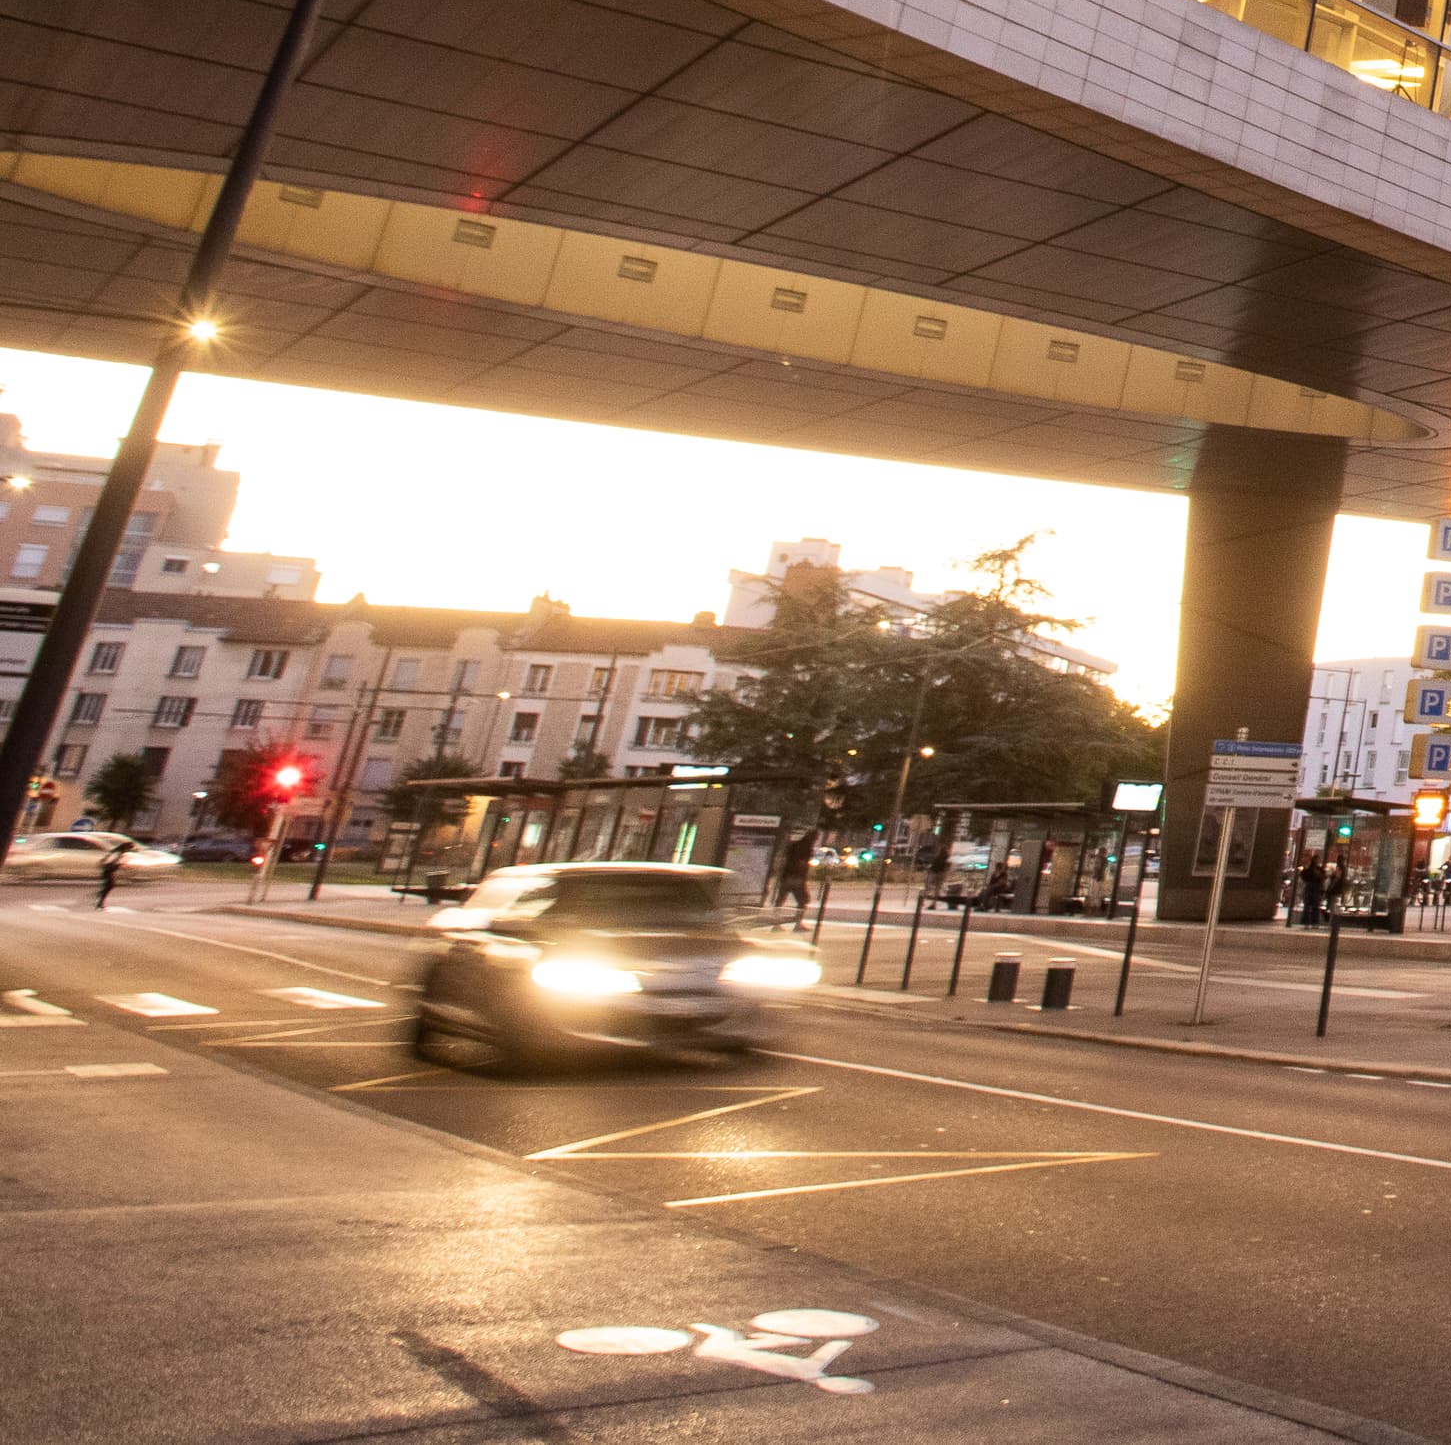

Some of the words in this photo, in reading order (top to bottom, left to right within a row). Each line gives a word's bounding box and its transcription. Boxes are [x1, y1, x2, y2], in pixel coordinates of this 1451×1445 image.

[1431, 639, 1447, 658] P
[1425, 693, 1441, 712] P
[1432, 748, 1448, 769] P
